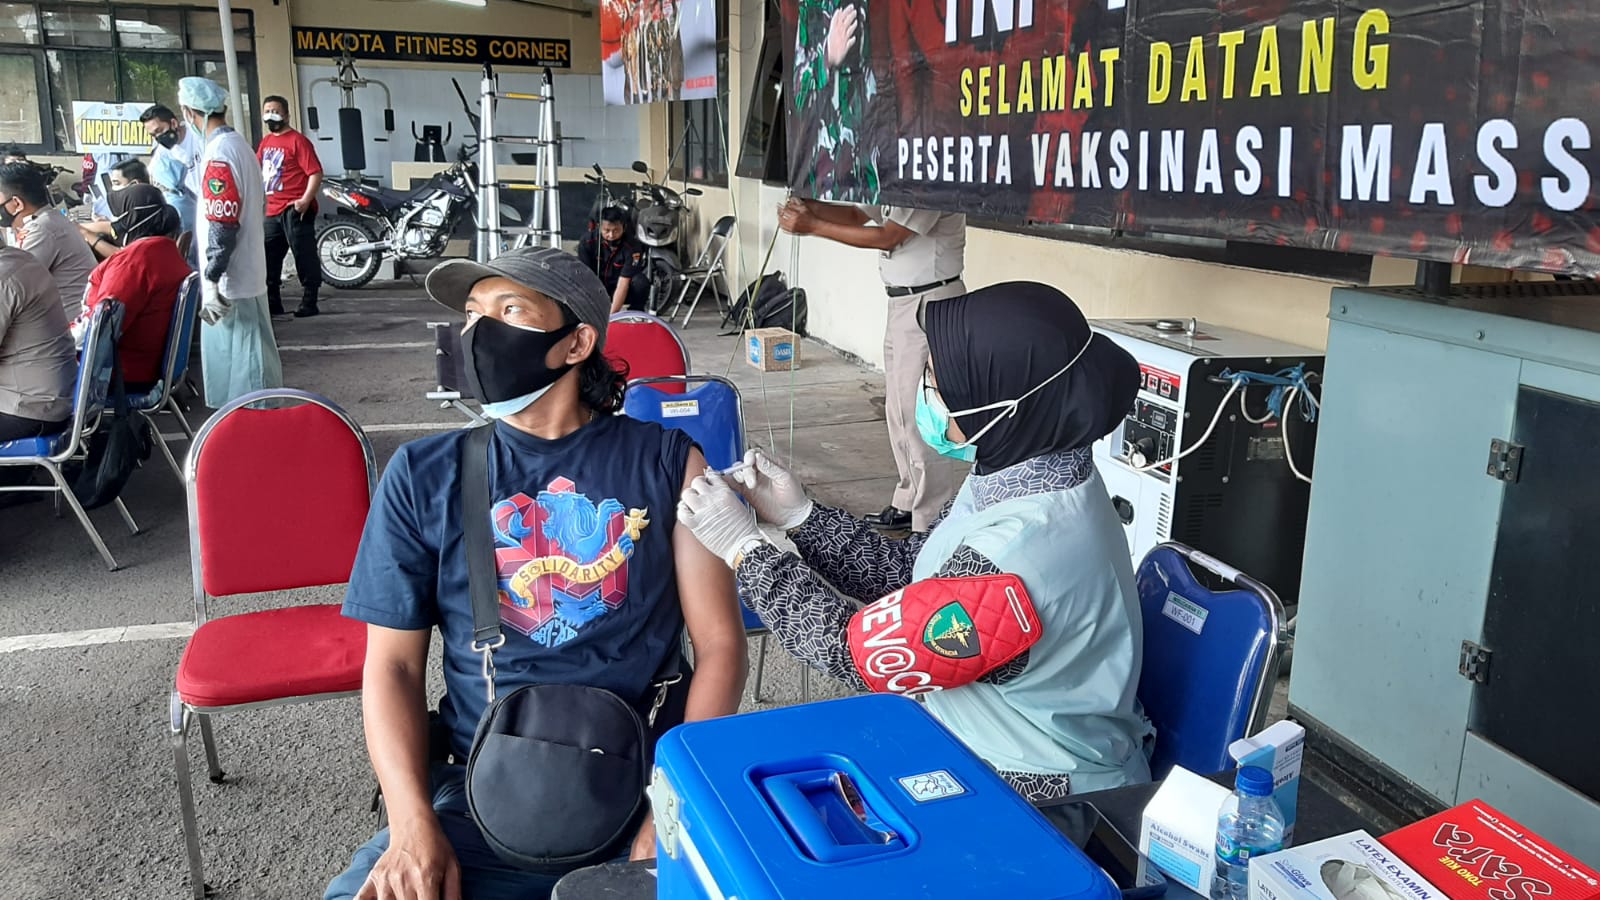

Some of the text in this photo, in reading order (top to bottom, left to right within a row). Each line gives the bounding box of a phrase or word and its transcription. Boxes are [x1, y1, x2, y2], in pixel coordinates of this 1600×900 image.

[296, 31, 568, 61] MAKOTA FITNESS CORNER
[959, 47, 1120, 117] SELAMAT
[1147, 8, 1391, 104] DATANG
[81, 119, 119, 146] INPUT
[897, 117, 1592, 212] PESERTA VAKSINASI MASS
[519, 553, 618, 583] SOLIDARITY
[1150, 823, 1182, 843] Alcohol
[1183, 839, 1209, 858] Swabs
[1356, 839, 1387, 865] LATEX
[1386, 864, 1432, 900] EXAMIN
[1433, 822, 1552, 900] Sara
[1438, 855, 1484, 888] TOKO KUE
